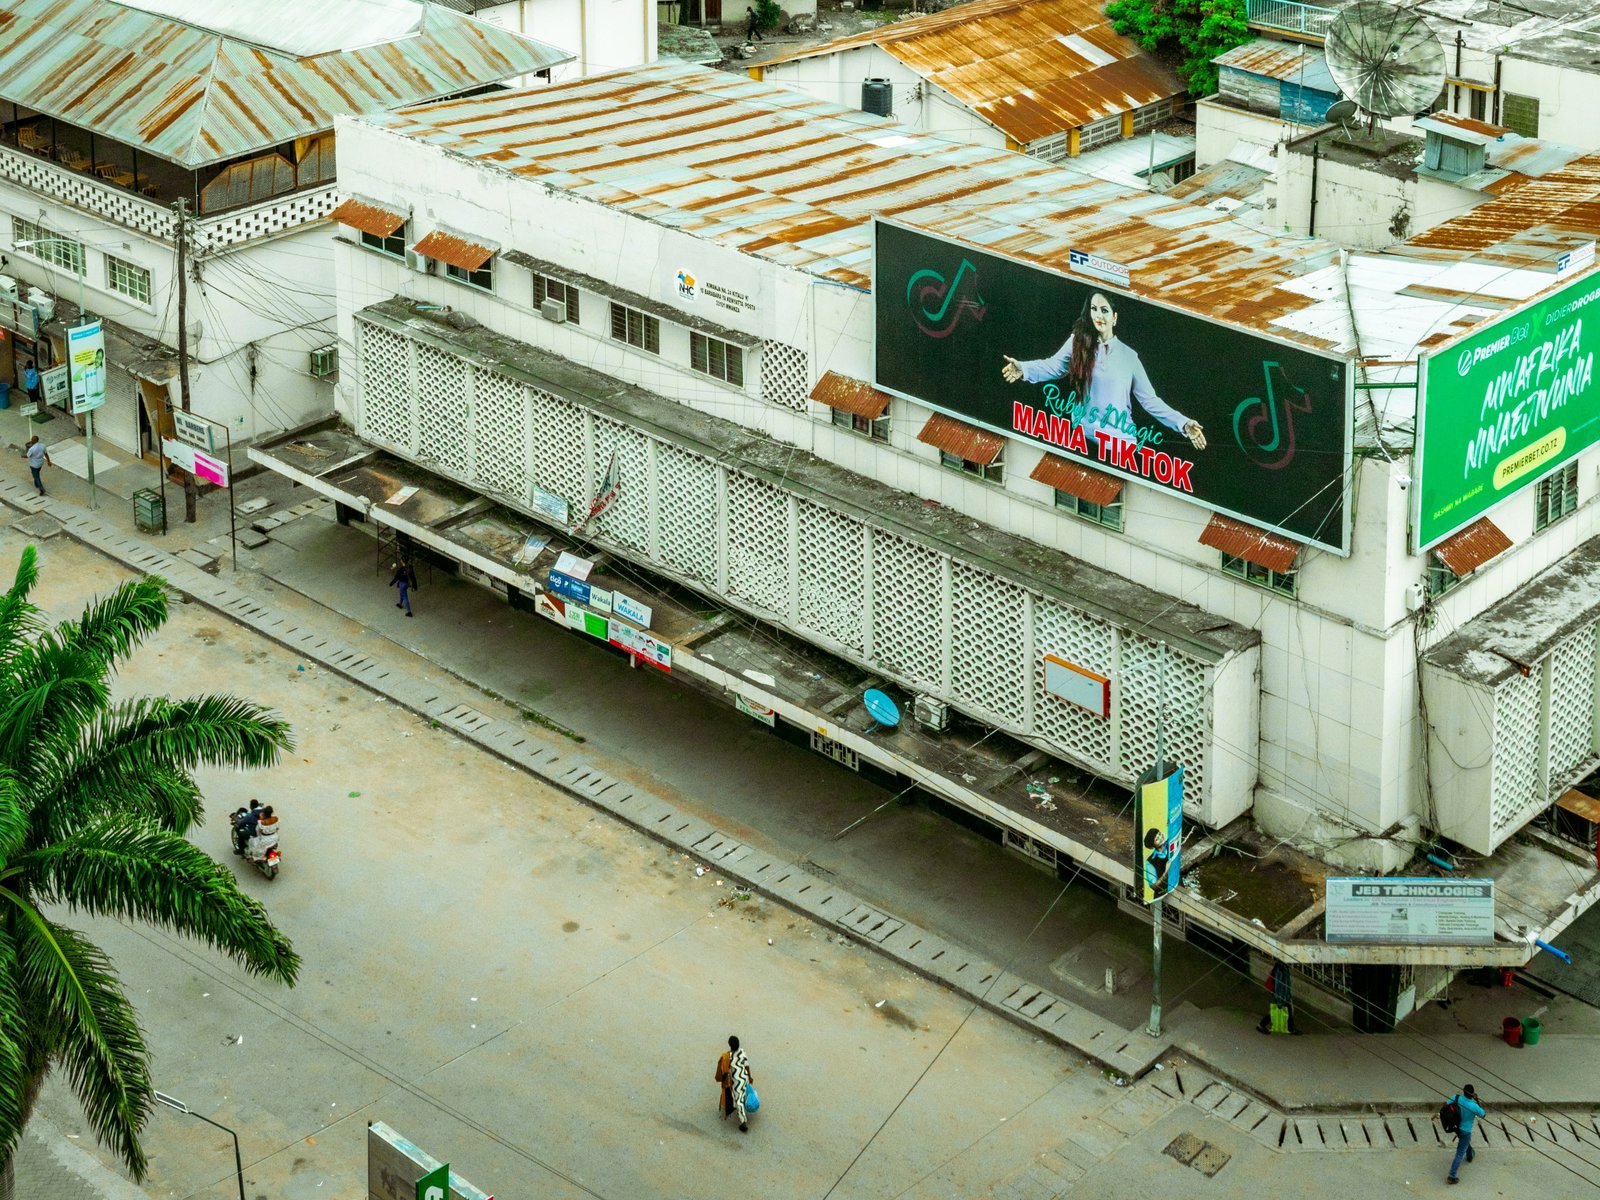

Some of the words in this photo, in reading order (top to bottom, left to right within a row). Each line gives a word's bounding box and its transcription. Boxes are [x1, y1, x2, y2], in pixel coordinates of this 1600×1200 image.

[1091, 258, 1129, 275] OUTDOOR
[679, 283, 695, 296] NHC
[1480, 318, 1583, 421] MWAFRIKA
[1043, 383, 1099, 429] Ruby's
[1100, 403, 1164, 451] Magic
[1012, 401, 1088, 455] MAMA
[1094, 430, 1194, 492] TIKTOK
[1502, 437, 1558, 478] PREMIERBET.CO.TZ
[550, 574, 562, 588] tigo
[591, 592, 612, 606] Wakala
[617, 603, 645, 622] WAKALA
[1355, 885, 1381, 895] JEB
[1383, 885, 1484, 896] TECHNOLOGIES
